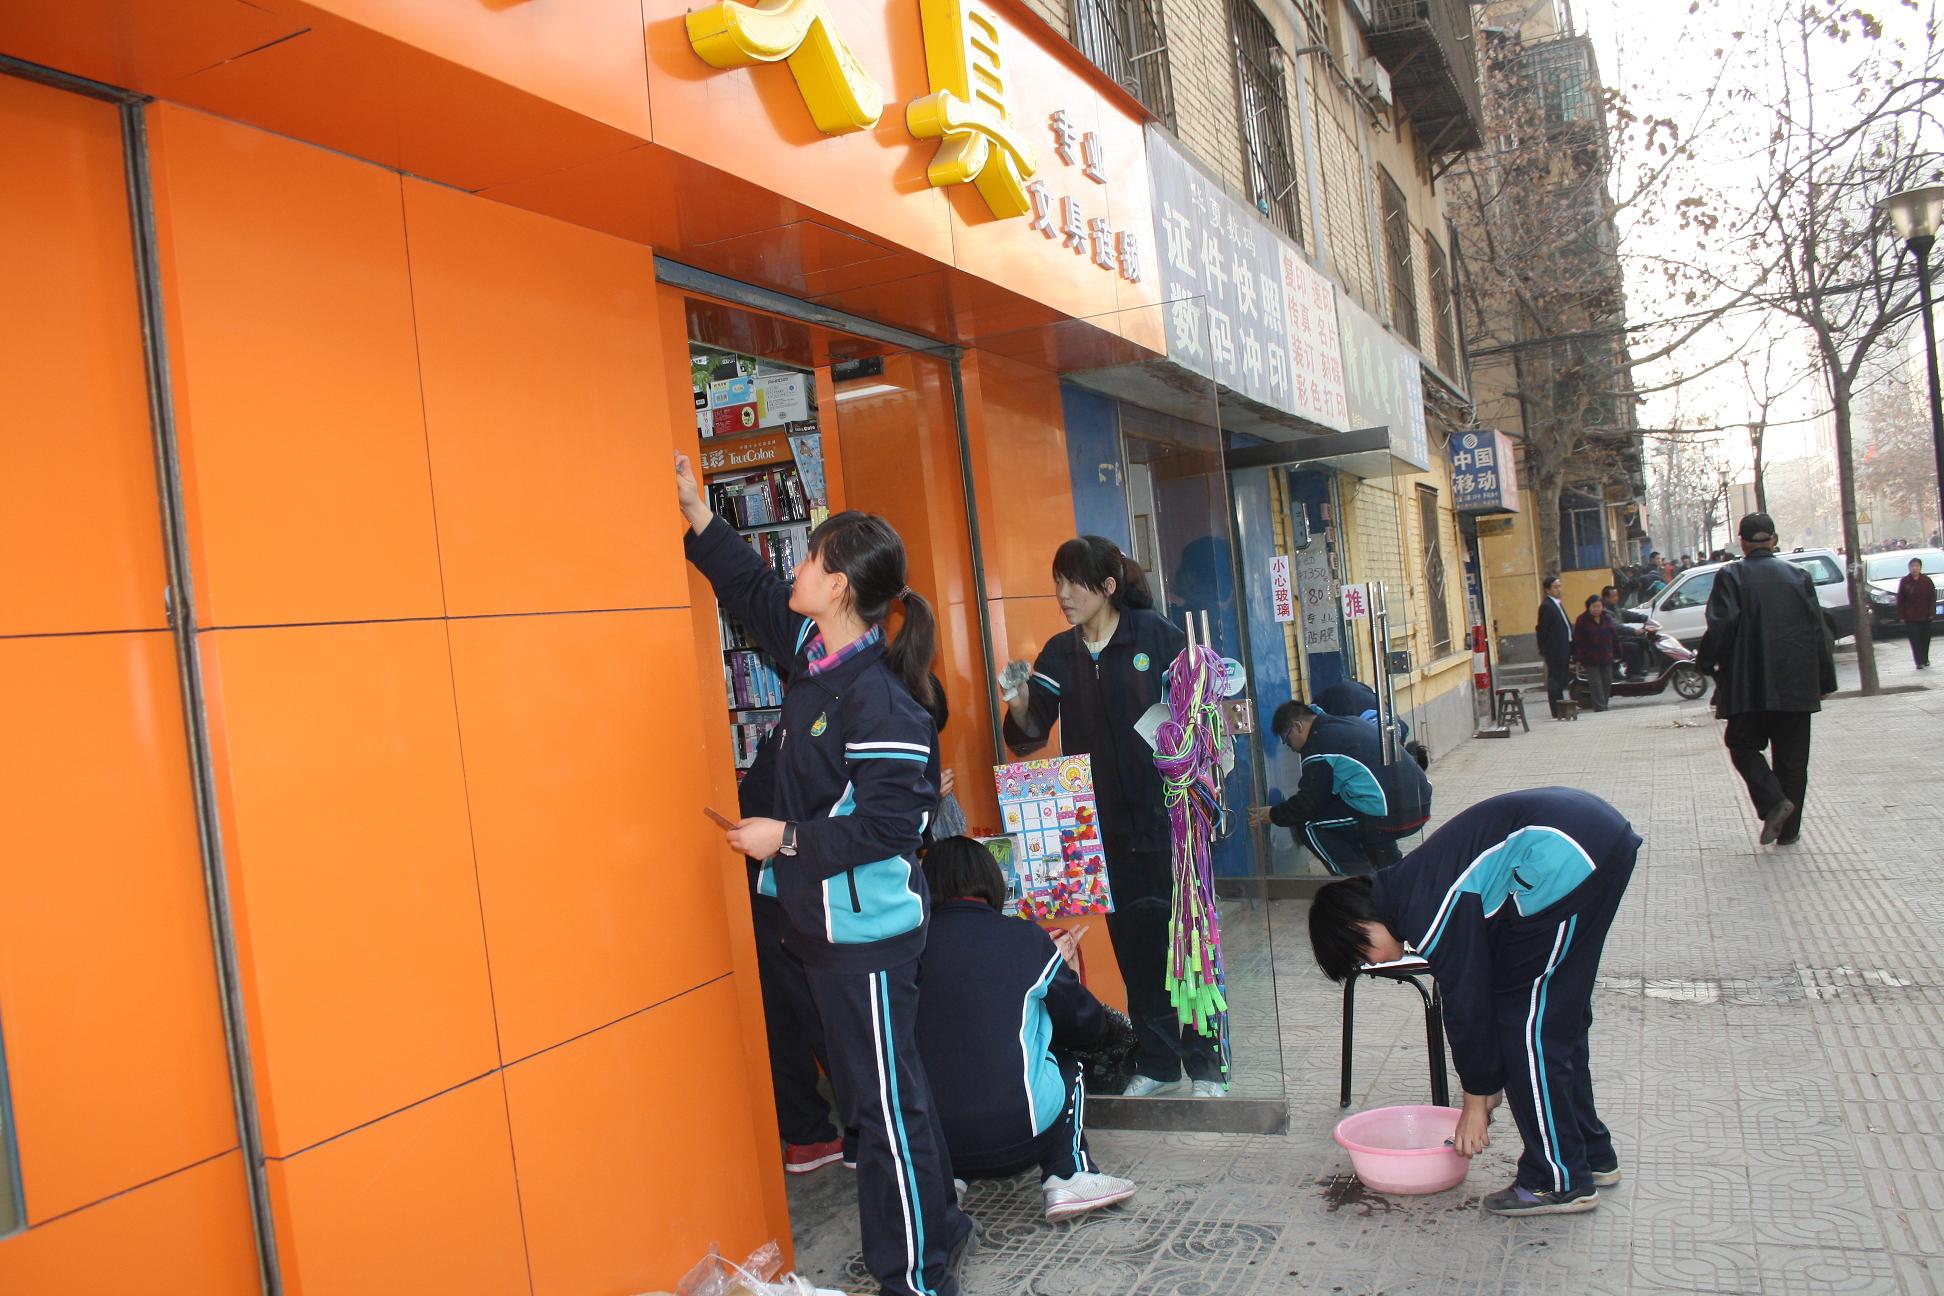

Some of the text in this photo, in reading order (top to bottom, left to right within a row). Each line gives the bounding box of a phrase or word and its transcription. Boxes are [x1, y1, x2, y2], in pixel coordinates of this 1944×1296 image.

[1049, 109, 1108, 185] 专业
[1026, 180, 1141, 284] 文具连锁
[1190, 182, 1257, 258] 华夏数码
[1162, 201, 1283, 335] 证件快照
[1169, 281, 1288, 398] 数码冲印
[1287, 294, 1337, 354] 传真 名片
[1295, 373, 1347, 419] 彩色打印
[1453, 447, 1494, 470] 中国
[1453, 471, 1497, 494] 移动
[1272, 559, 1290, 617] 小心玻璃
[1345, 588, 1366, 618] 推
